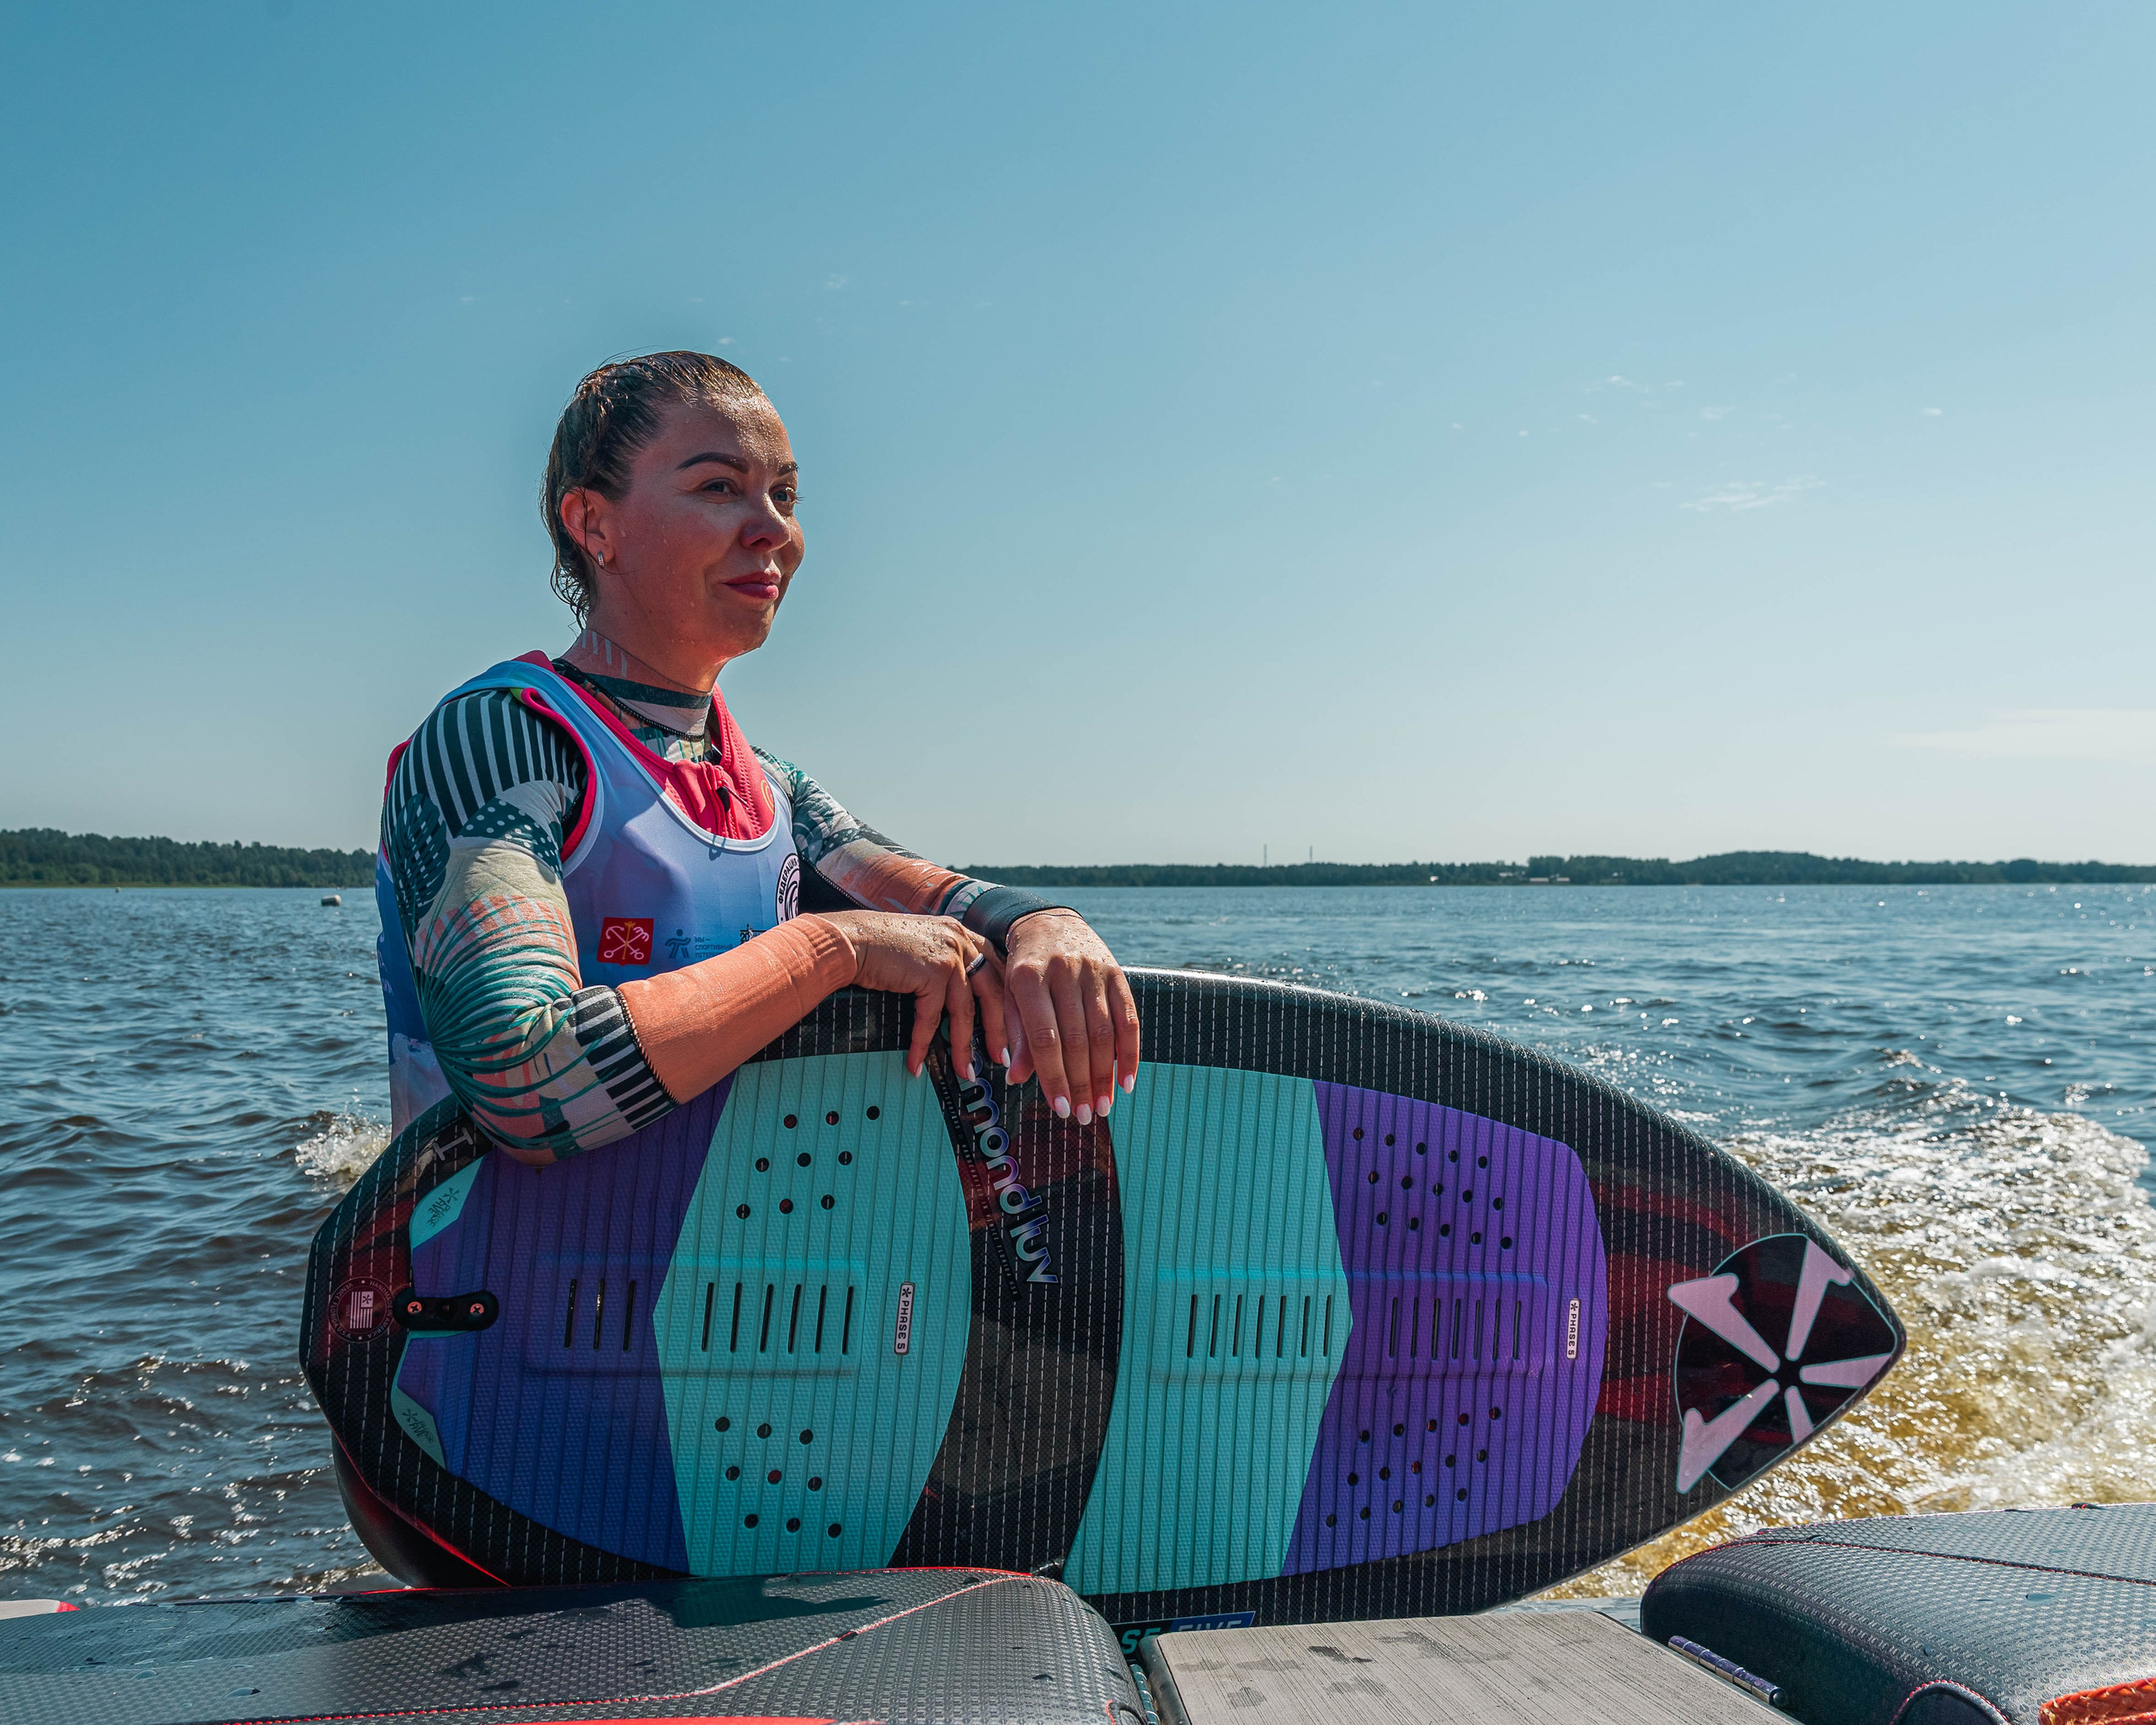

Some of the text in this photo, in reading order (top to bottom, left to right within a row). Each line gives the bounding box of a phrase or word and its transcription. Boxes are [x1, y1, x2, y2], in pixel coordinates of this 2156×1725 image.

[778, 858, 798, 904] ФЕДЕРАЦИЯ
[961, 1143, 984, 1198] HANDCRAFTED
[985, 1213, 999, 1241] VENICE
[996, 1245, 1012, 1277] FLORIDA
[1009, 1280, 1018, 1295] USA
[1010, 1215, 1058, 1283] luv
[330, 1301, 339, 1327] FLORIDA
[898, 1300, 910, 1339] PHASE
[1568, 1313, 1577, 1347] PHASE
